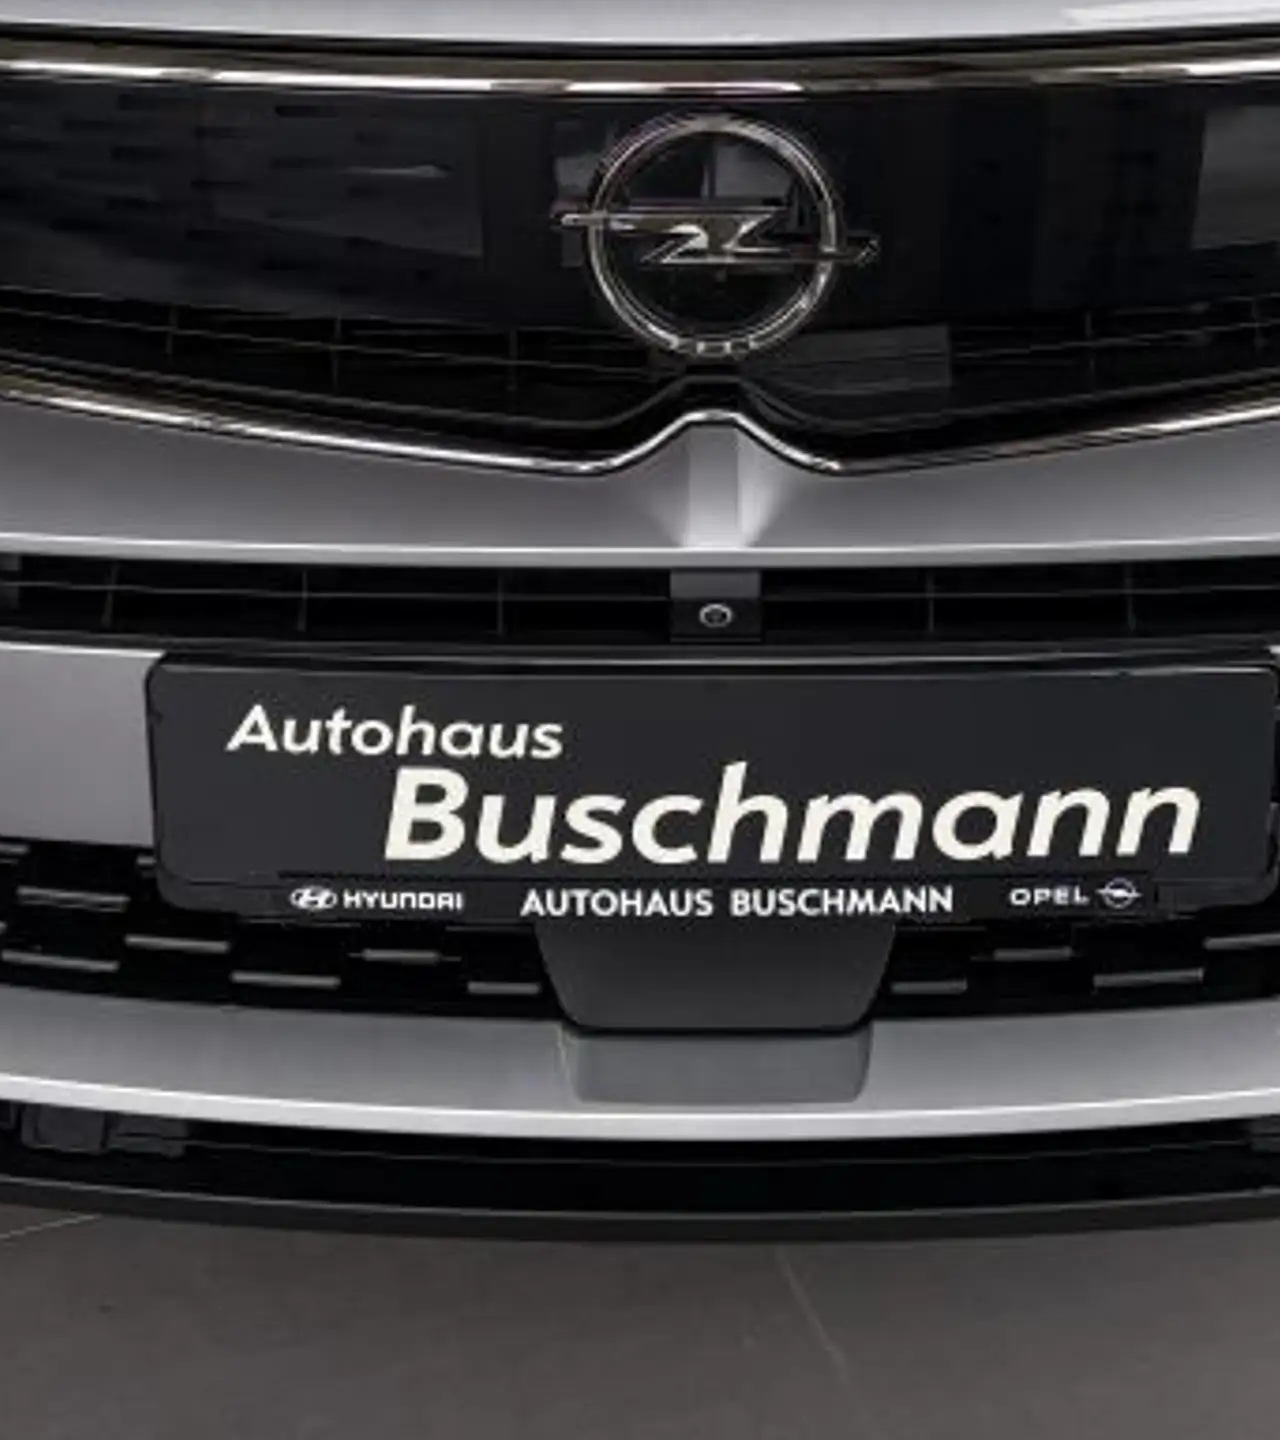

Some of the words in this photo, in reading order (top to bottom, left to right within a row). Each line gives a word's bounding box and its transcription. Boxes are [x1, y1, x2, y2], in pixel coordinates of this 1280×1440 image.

[226, 703, 563, 759] Autohaus
[384, 760, 1200, 865] Buschmann
[342, 889, 464, 911] HYUNDAI
[520, 887, 714, 918] AUTOHAUS
[730, 885, 953, 918] BUSCHMANN
[1009, 886, 1089, 907] OPEL
